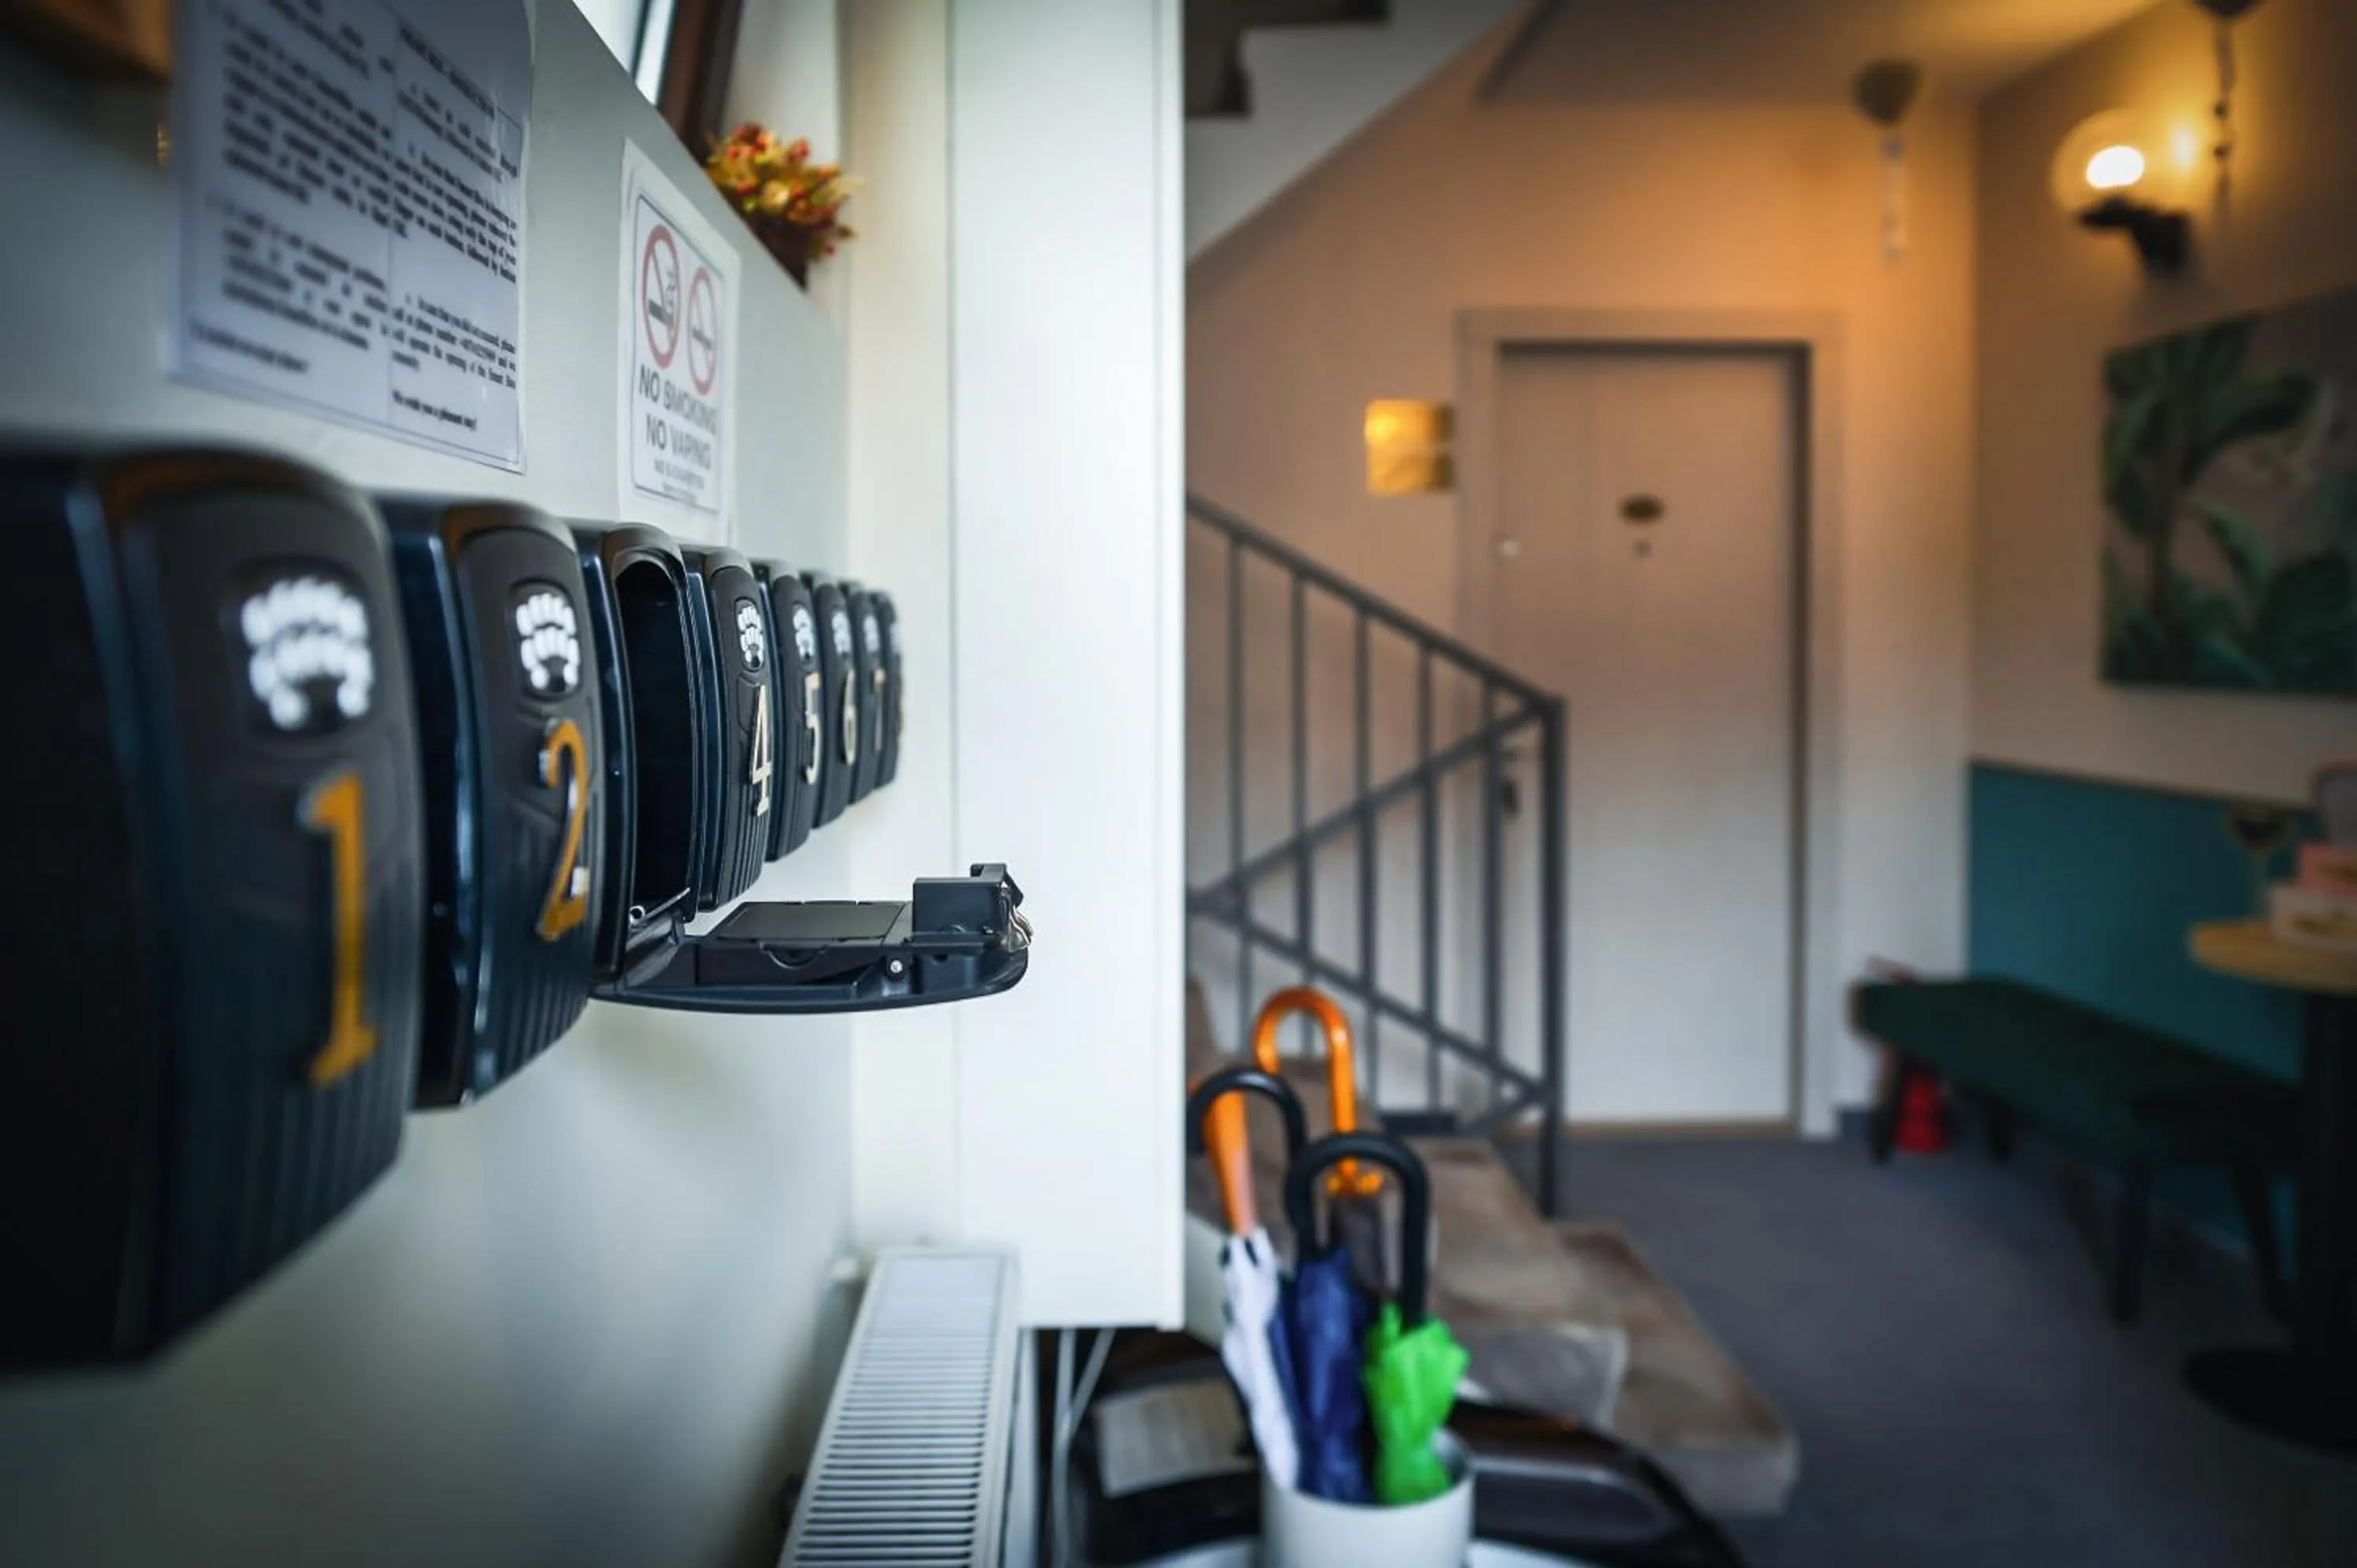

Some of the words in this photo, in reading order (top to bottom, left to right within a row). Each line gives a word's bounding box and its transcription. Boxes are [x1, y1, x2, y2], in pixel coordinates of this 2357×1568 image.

[639, 364, 660, 403] NO
[646, 412, 666, 451] NO
[752, 684, 772, 817] 4
[805, 672, 820, 785] 5
[538, 718, 588, 940] 2
[302, 770, 377, 1084] 1
